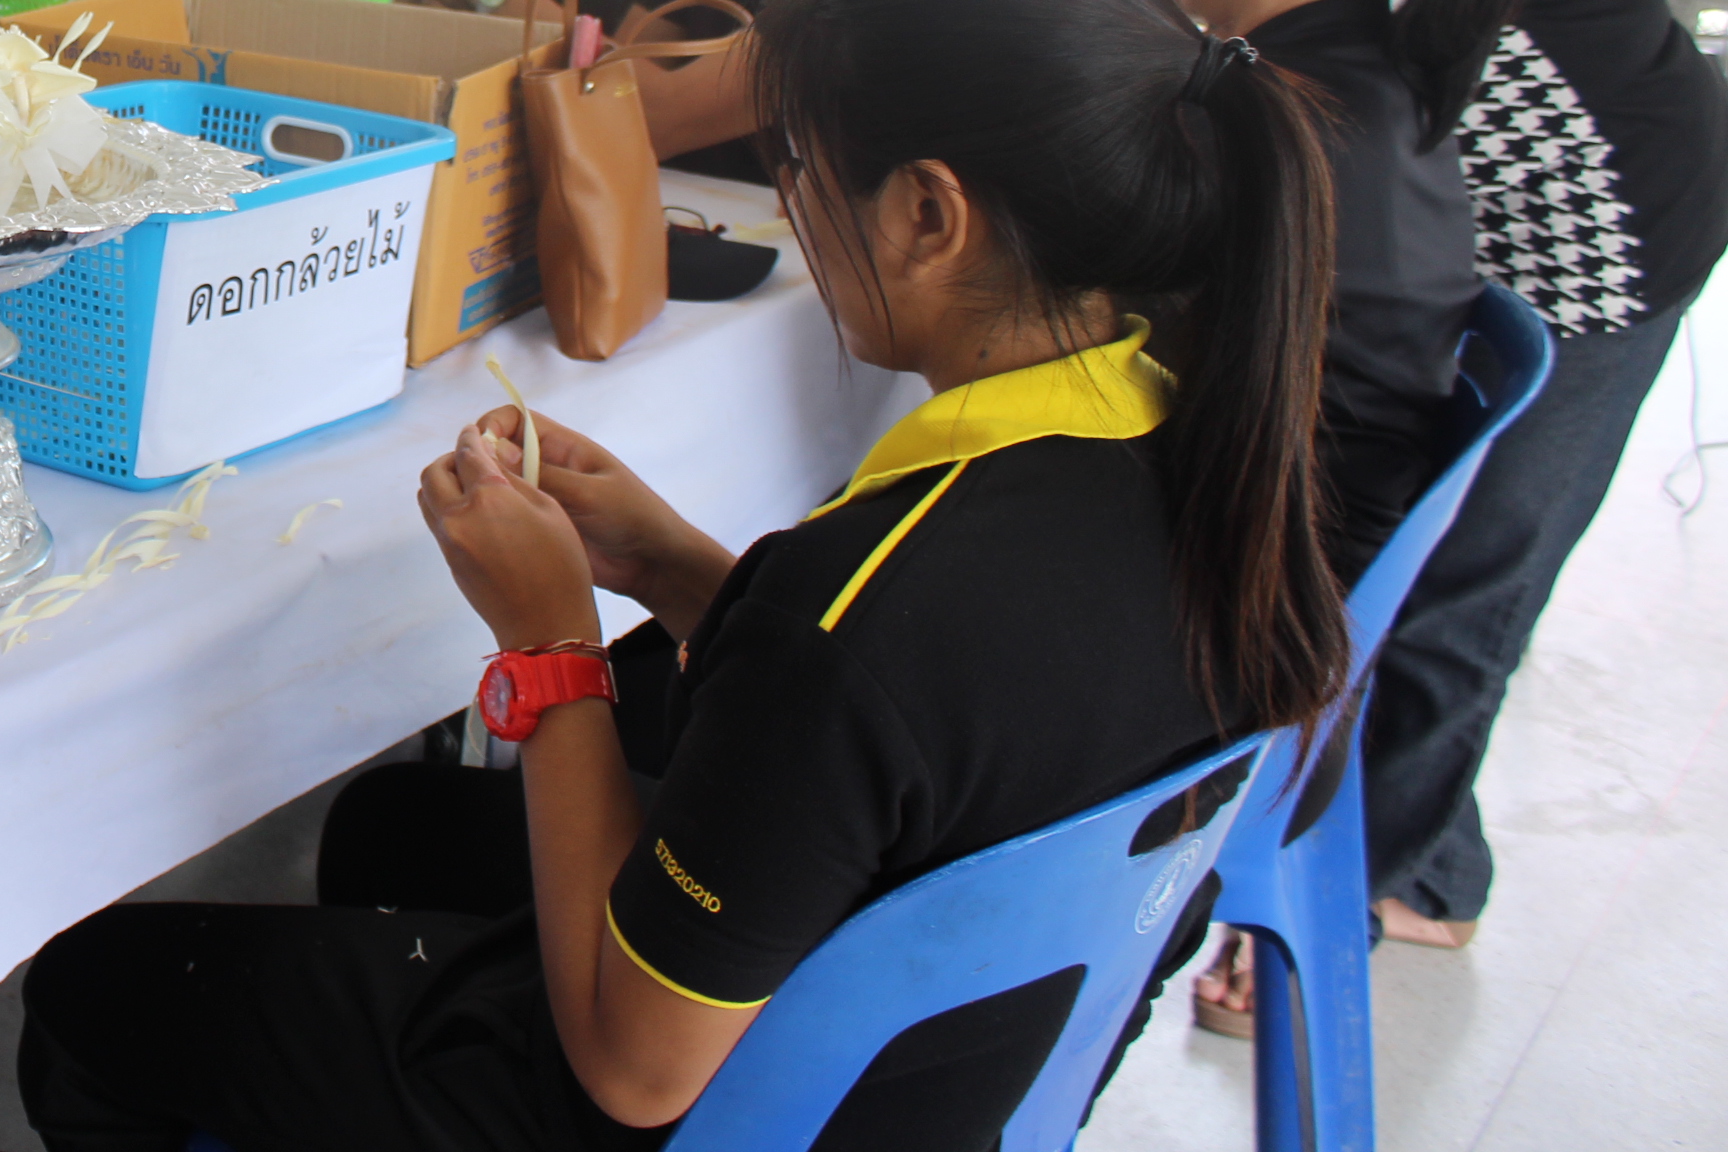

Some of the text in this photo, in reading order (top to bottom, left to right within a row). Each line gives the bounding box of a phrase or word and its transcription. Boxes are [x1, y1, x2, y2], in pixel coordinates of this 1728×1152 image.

[186, 201, 410, 326] ดอกกล้วยไม้
